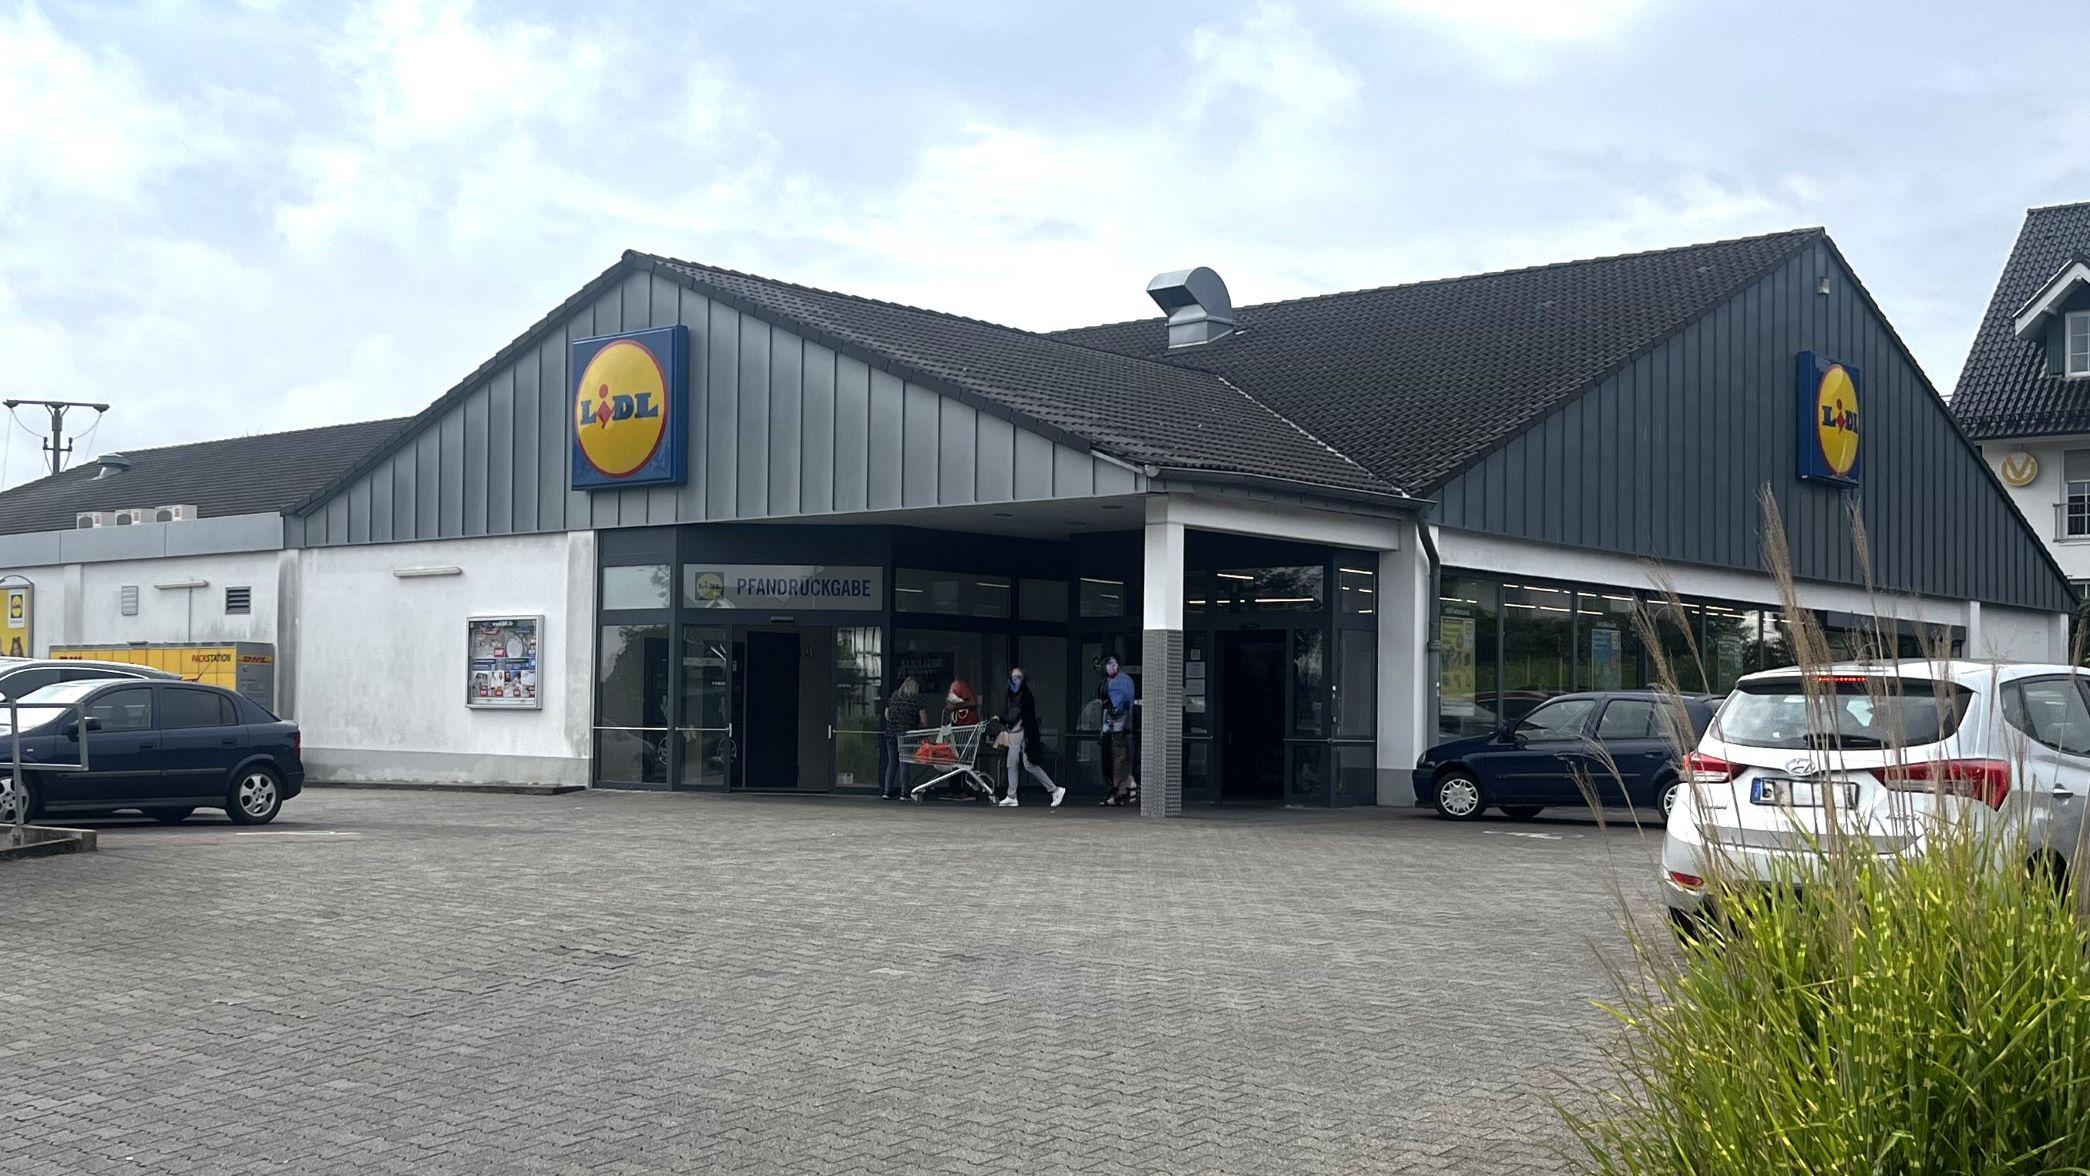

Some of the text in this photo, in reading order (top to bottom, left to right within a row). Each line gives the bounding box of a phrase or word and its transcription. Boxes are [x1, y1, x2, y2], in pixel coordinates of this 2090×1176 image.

[736, 575, 872, 597] PFANDRÜCKGABE
[191, 653, 232, 663] PACKSTATION
[242, 655, 268, 663] DHL
